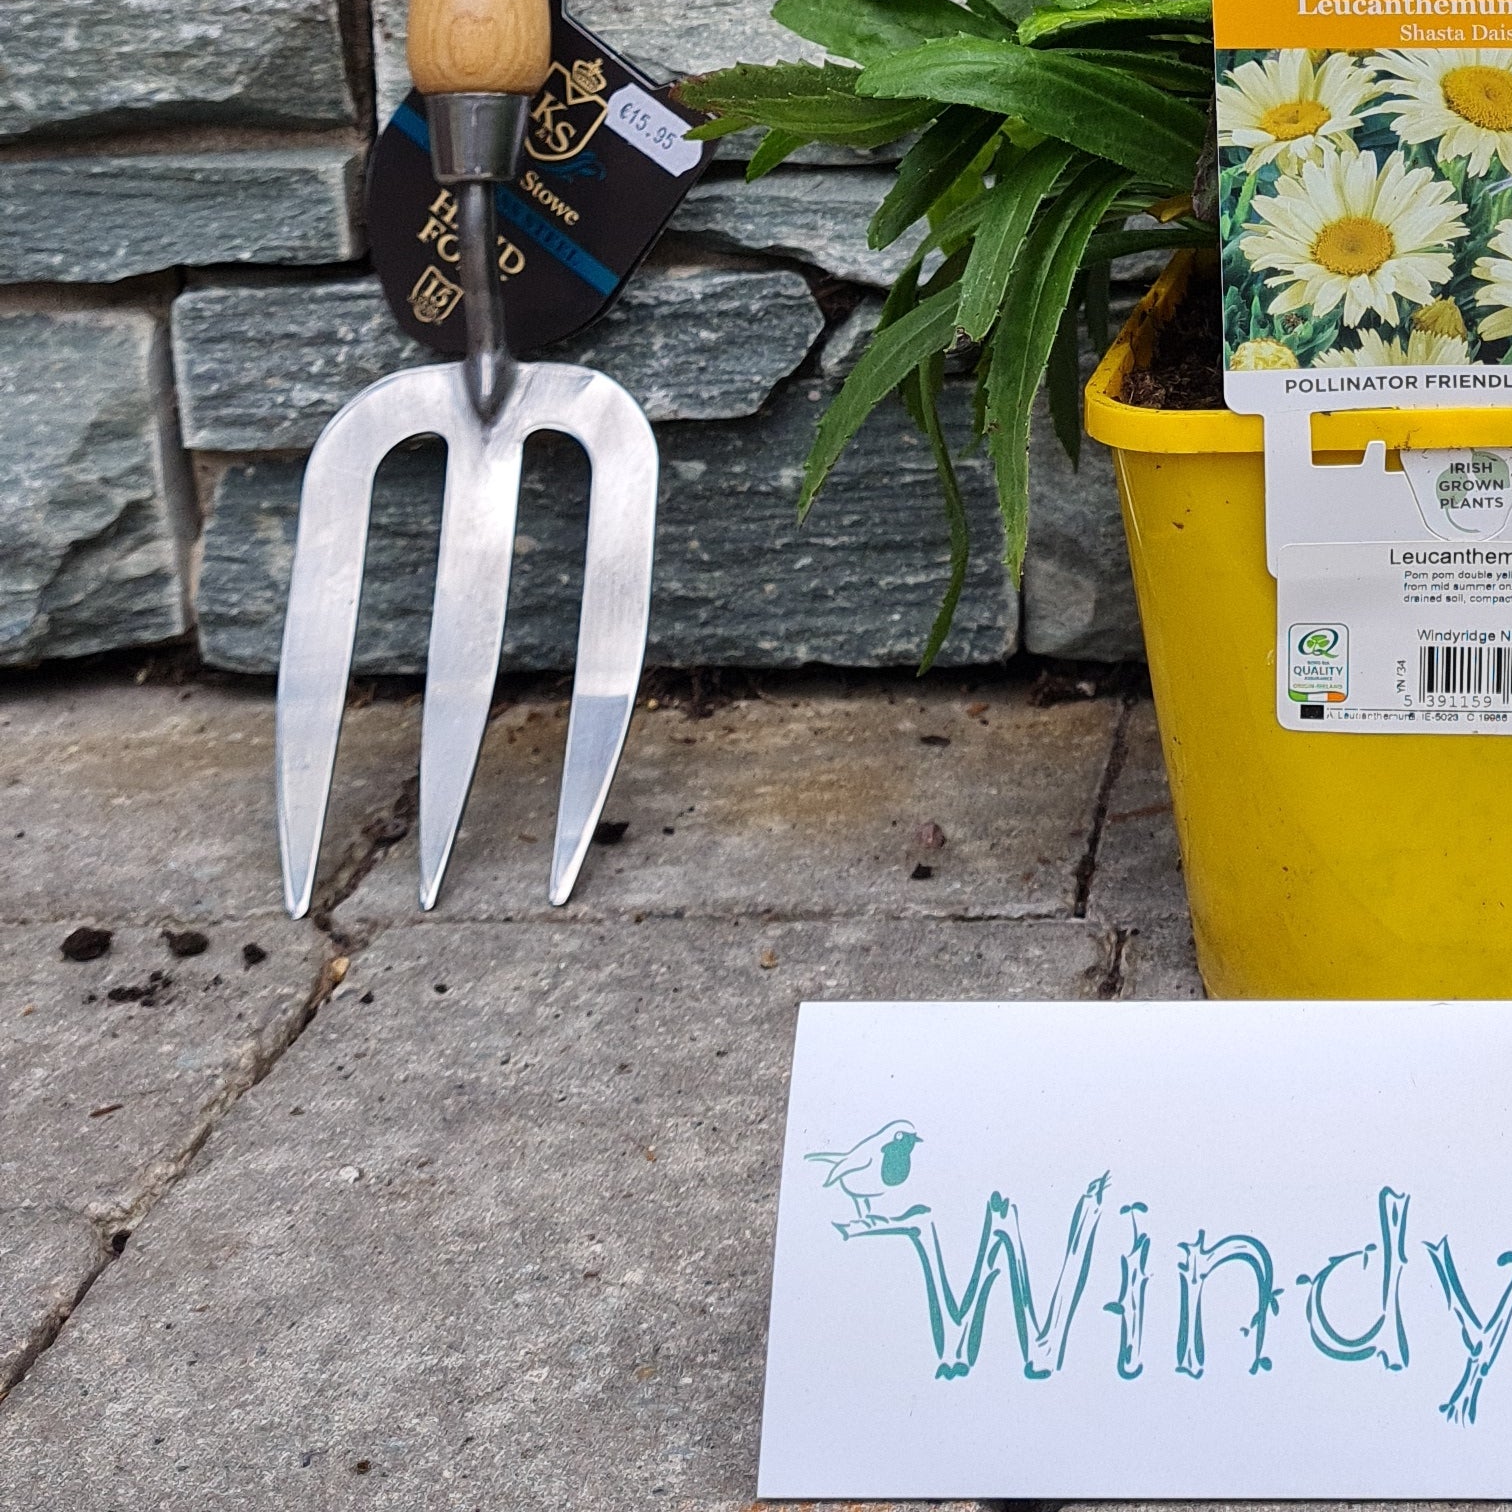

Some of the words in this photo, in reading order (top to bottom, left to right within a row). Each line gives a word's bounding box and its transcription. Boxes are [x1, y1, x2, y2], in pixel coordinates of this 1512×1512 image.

[1400, 24, 1466, 42] Shasta
[619, 102, 676, 150] €15.95
[520, 170, 580, 226] Stowe
[1285, 375, 1418, 394] POLLINATOR
[1450, 462, 1493, 474] IRISH
[1439, 480, 1504, 491] GROWN
[1440, 497, 1504, 509] PLANTS
[1404, 570, 1428, 579] Pom
[1432, 571, 1454, 583] pom
[1458, 570, 1493, 579] double
[1404, 582, 1427, 591] from
[1431, 582, 1449, 591] mid
[1453, 583, 1496, 591] summer
[1404, 594, 1442, 603] drained
[1417, 629, 1495, 644] Windyridge
[1293, 666, 1343, 676] QUALITY
[1403, 695, 1413, 707] 5
[1426, 695, 1492, 708] 391159
[1466, 713, 1474, 722] C
